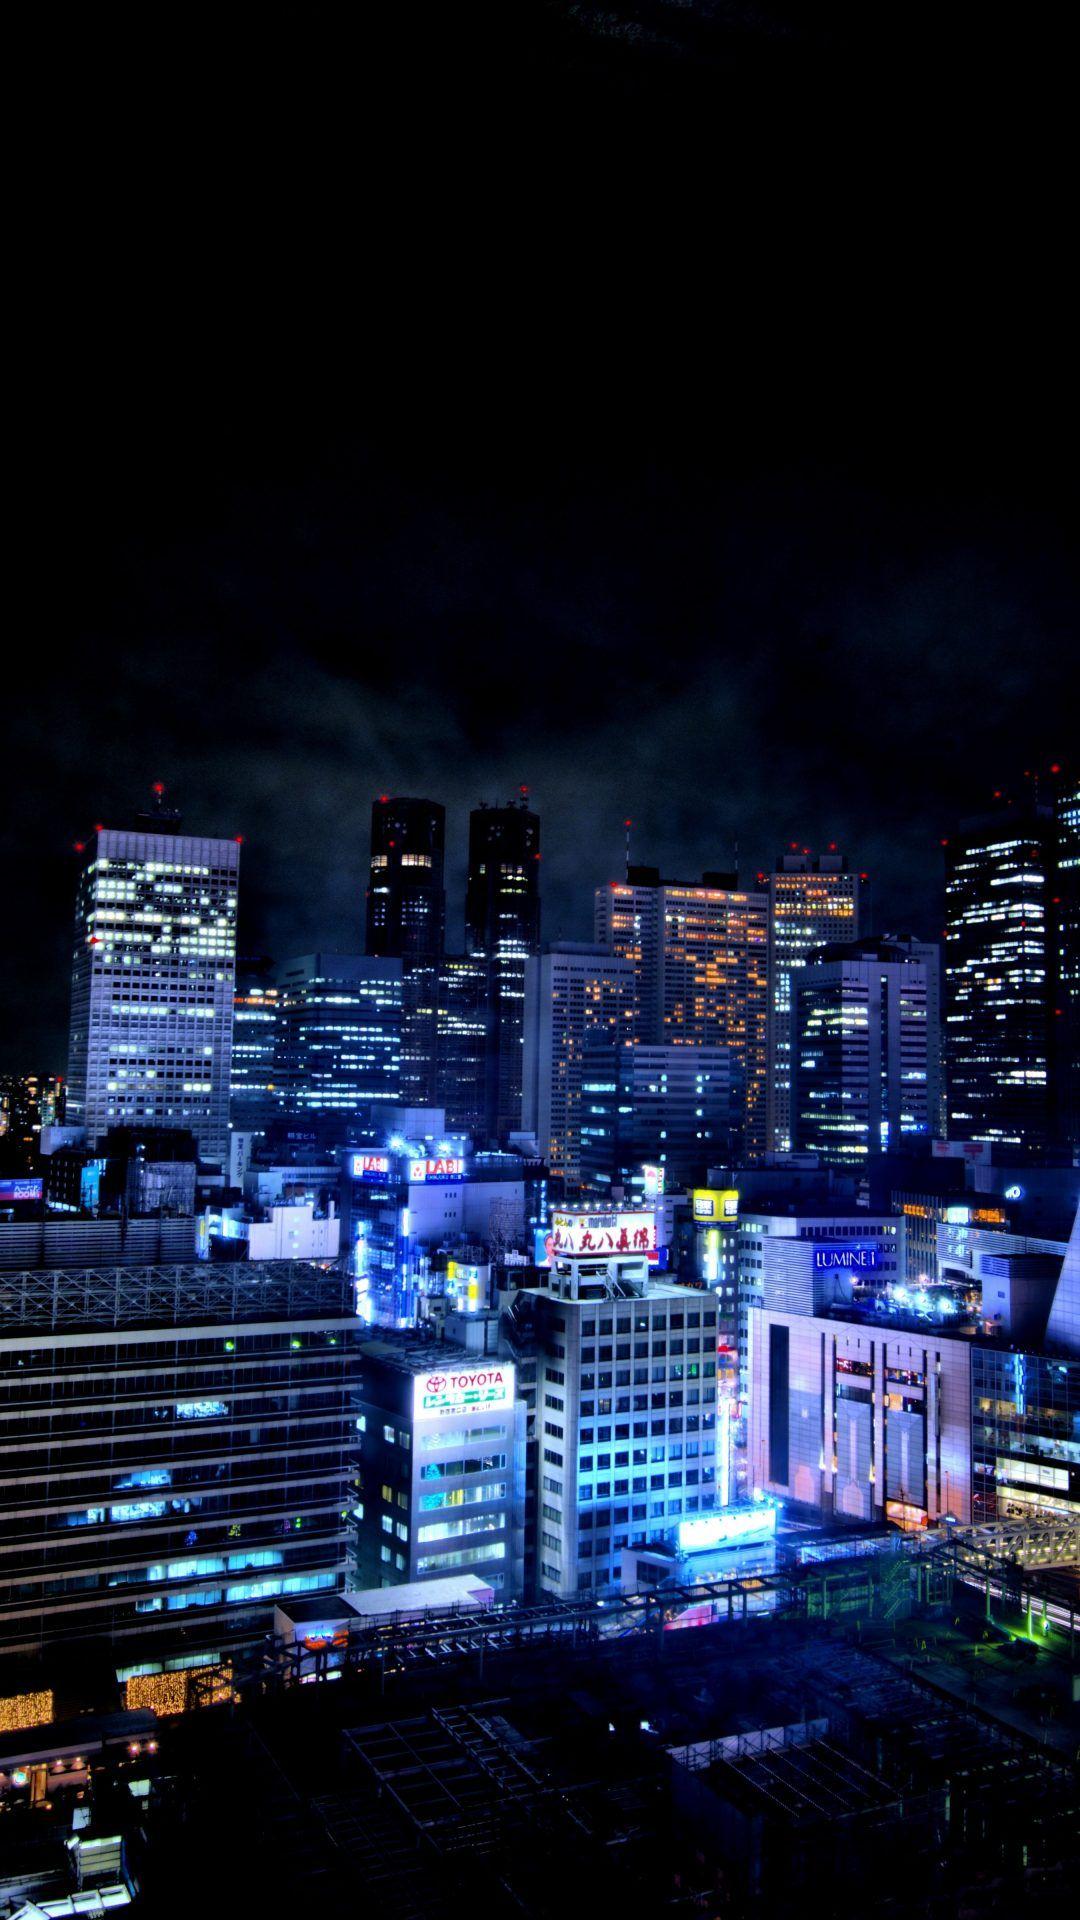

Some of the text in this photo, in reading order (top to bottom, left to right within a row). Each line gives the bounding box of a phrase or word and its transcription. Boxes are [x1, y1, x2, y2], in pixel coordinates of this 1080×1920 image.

[425, 1159, 461, 1174] LABI
[816, 1251, 867, 1267] LUMINE
[450, 1372, 503, 1389] TOYOTA
